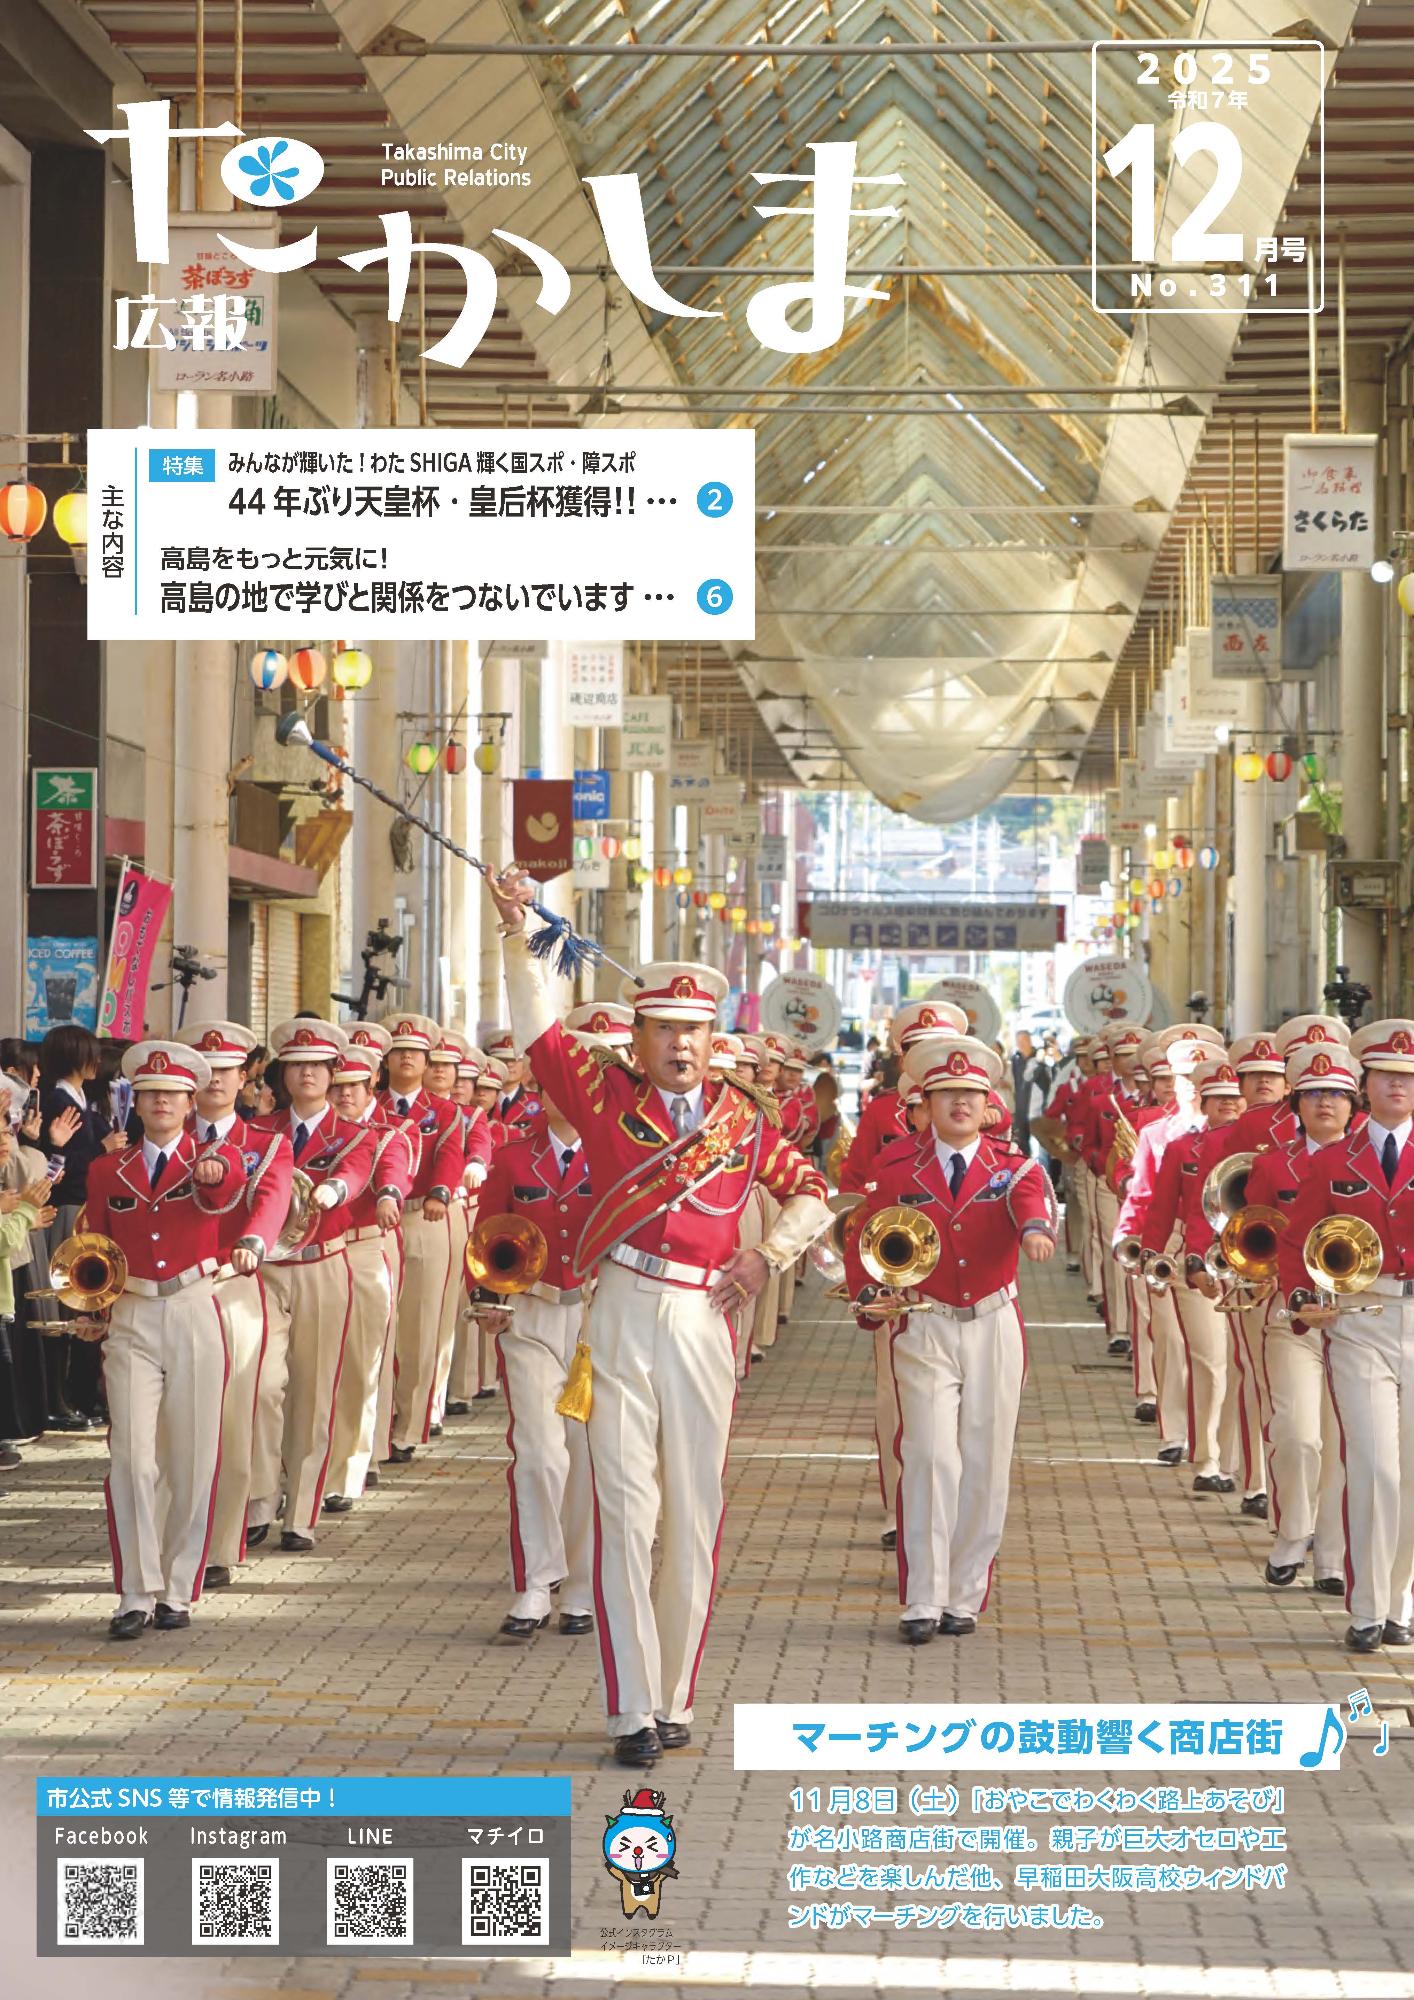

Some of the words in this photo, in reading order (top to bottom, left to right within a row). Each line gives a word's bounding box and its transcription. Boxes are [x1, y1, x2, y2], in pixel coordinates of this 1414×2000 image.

[181, 263, 256, 290] 茶ぼうず
[1294, 510, 1369, 533] さくらた
[42, 775, 86, 806] 茶
[45, 811, 72, 882] 茶ぼうず
[1085, 962, 1127, 973] WASEDA
